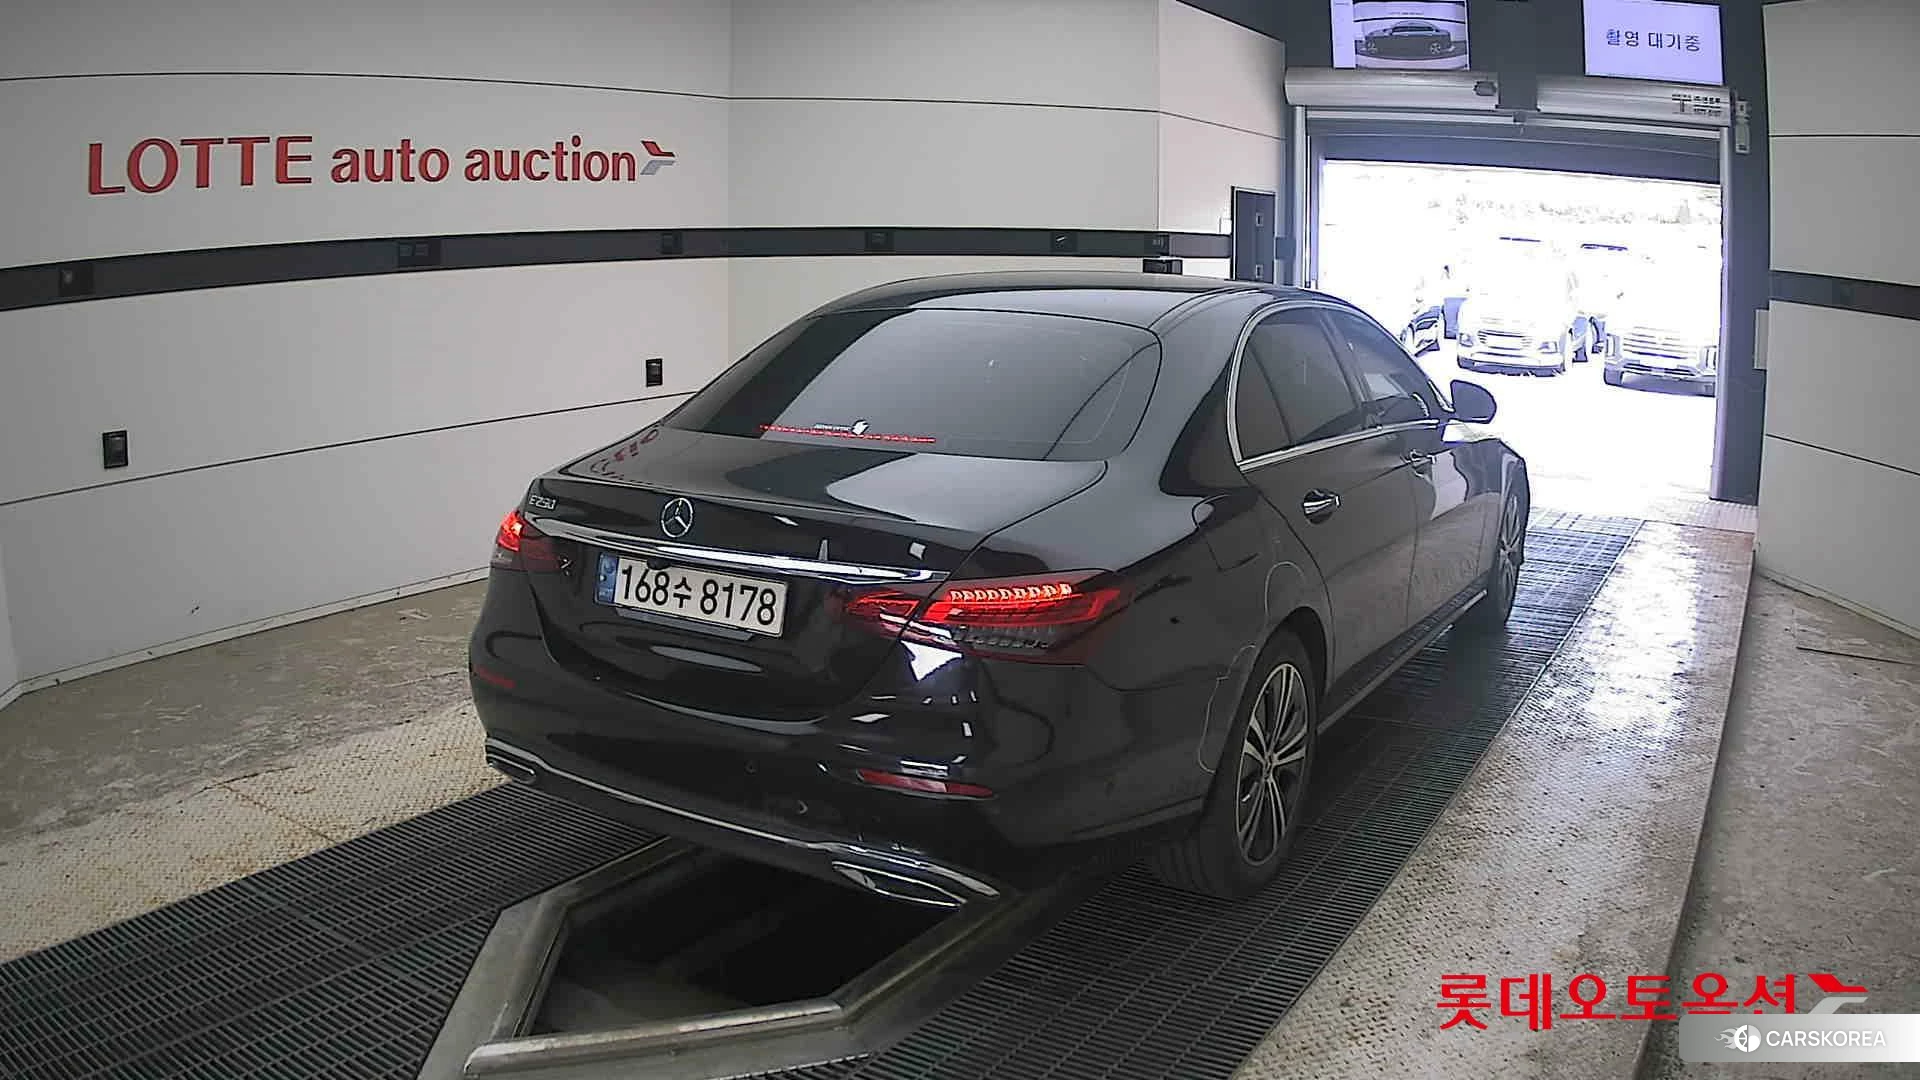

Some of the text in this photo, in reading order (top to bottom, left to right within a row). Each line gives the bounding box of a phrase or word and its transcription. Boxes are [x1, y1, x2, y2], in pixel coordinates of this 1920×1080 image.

[1647, 32, 1700, 52] 대기중
[89, 135, 636, 195] LOTTE auto auction
[620, 564, 777, 626] 168수 8178
